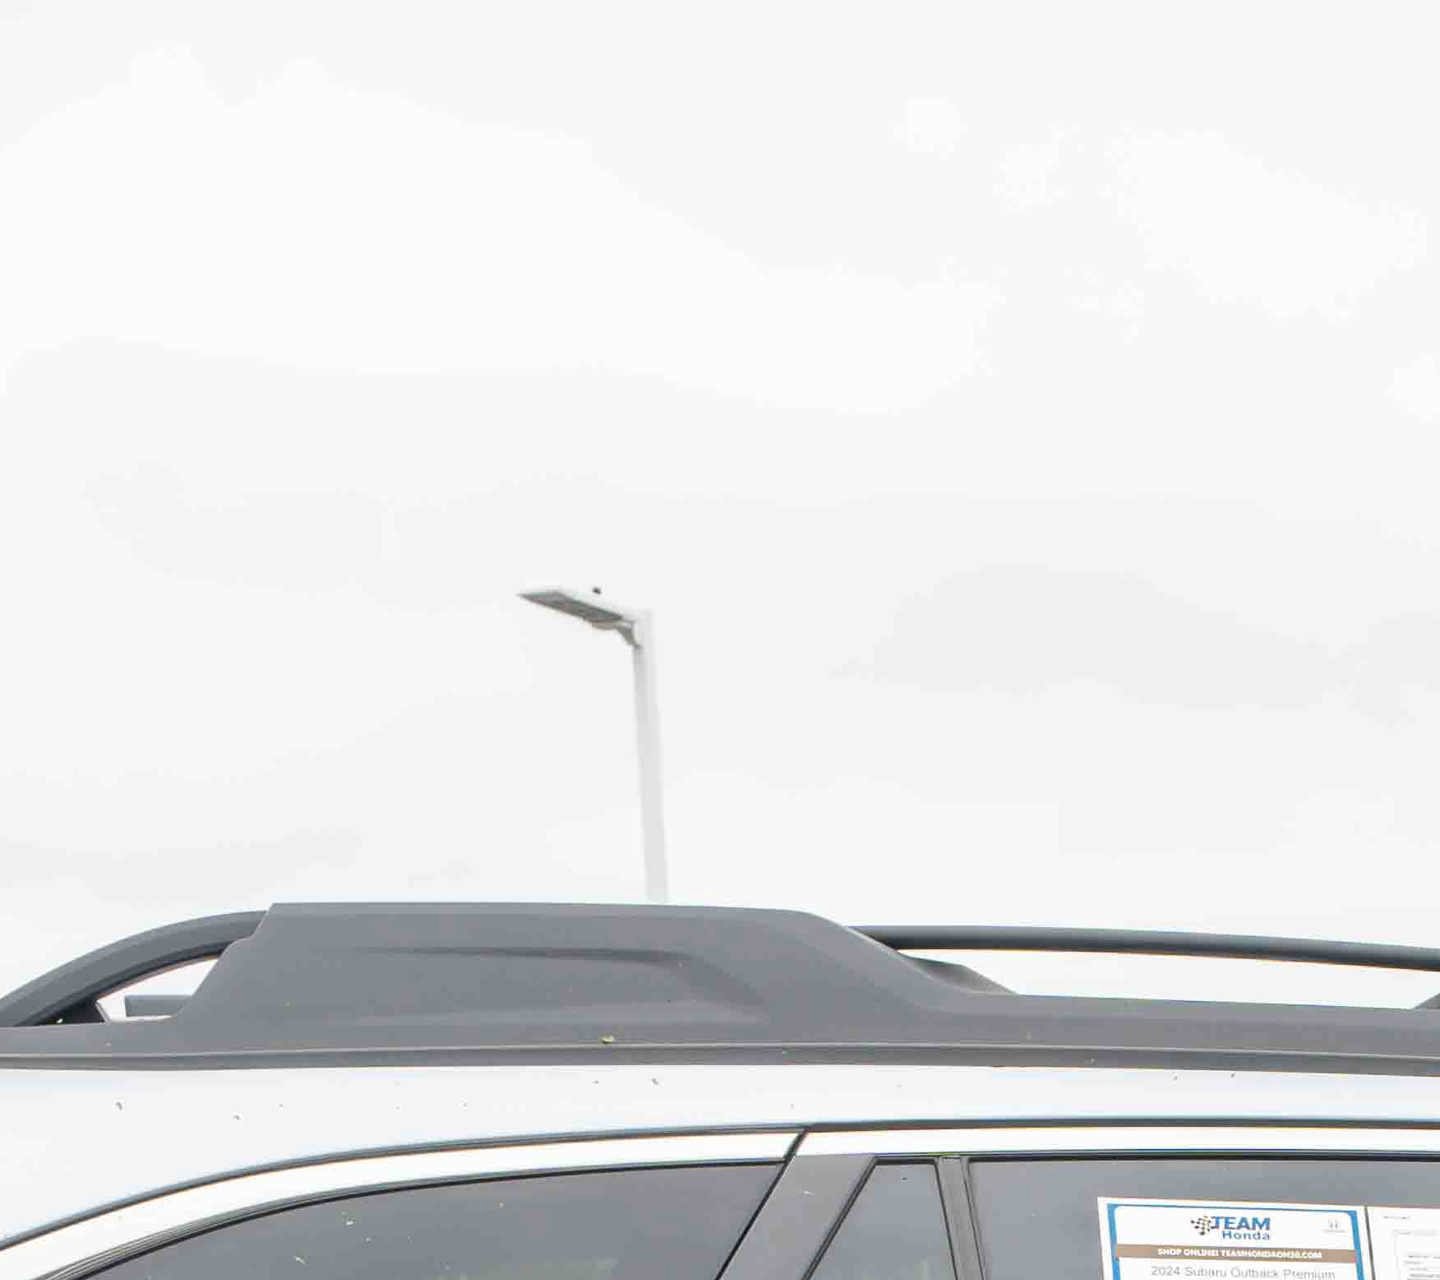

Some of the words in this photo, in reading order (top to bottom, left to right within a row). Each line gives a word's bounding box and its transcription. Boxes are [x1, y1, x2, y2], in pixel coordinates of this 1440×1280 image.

[1211, 1215, 1271, 1231] TEAM
[1222, 1230, 1271, 1241] Honda
[1158, 1248, 1182, 1256] SHOP
[1151, 1265, 1181, 1277] 2024
[1185, 1266, 1228, 1279] Subaru
[1230, 1267, 1279, 1280] Outback
[1283, 1269, 1336, 1280] Premium
